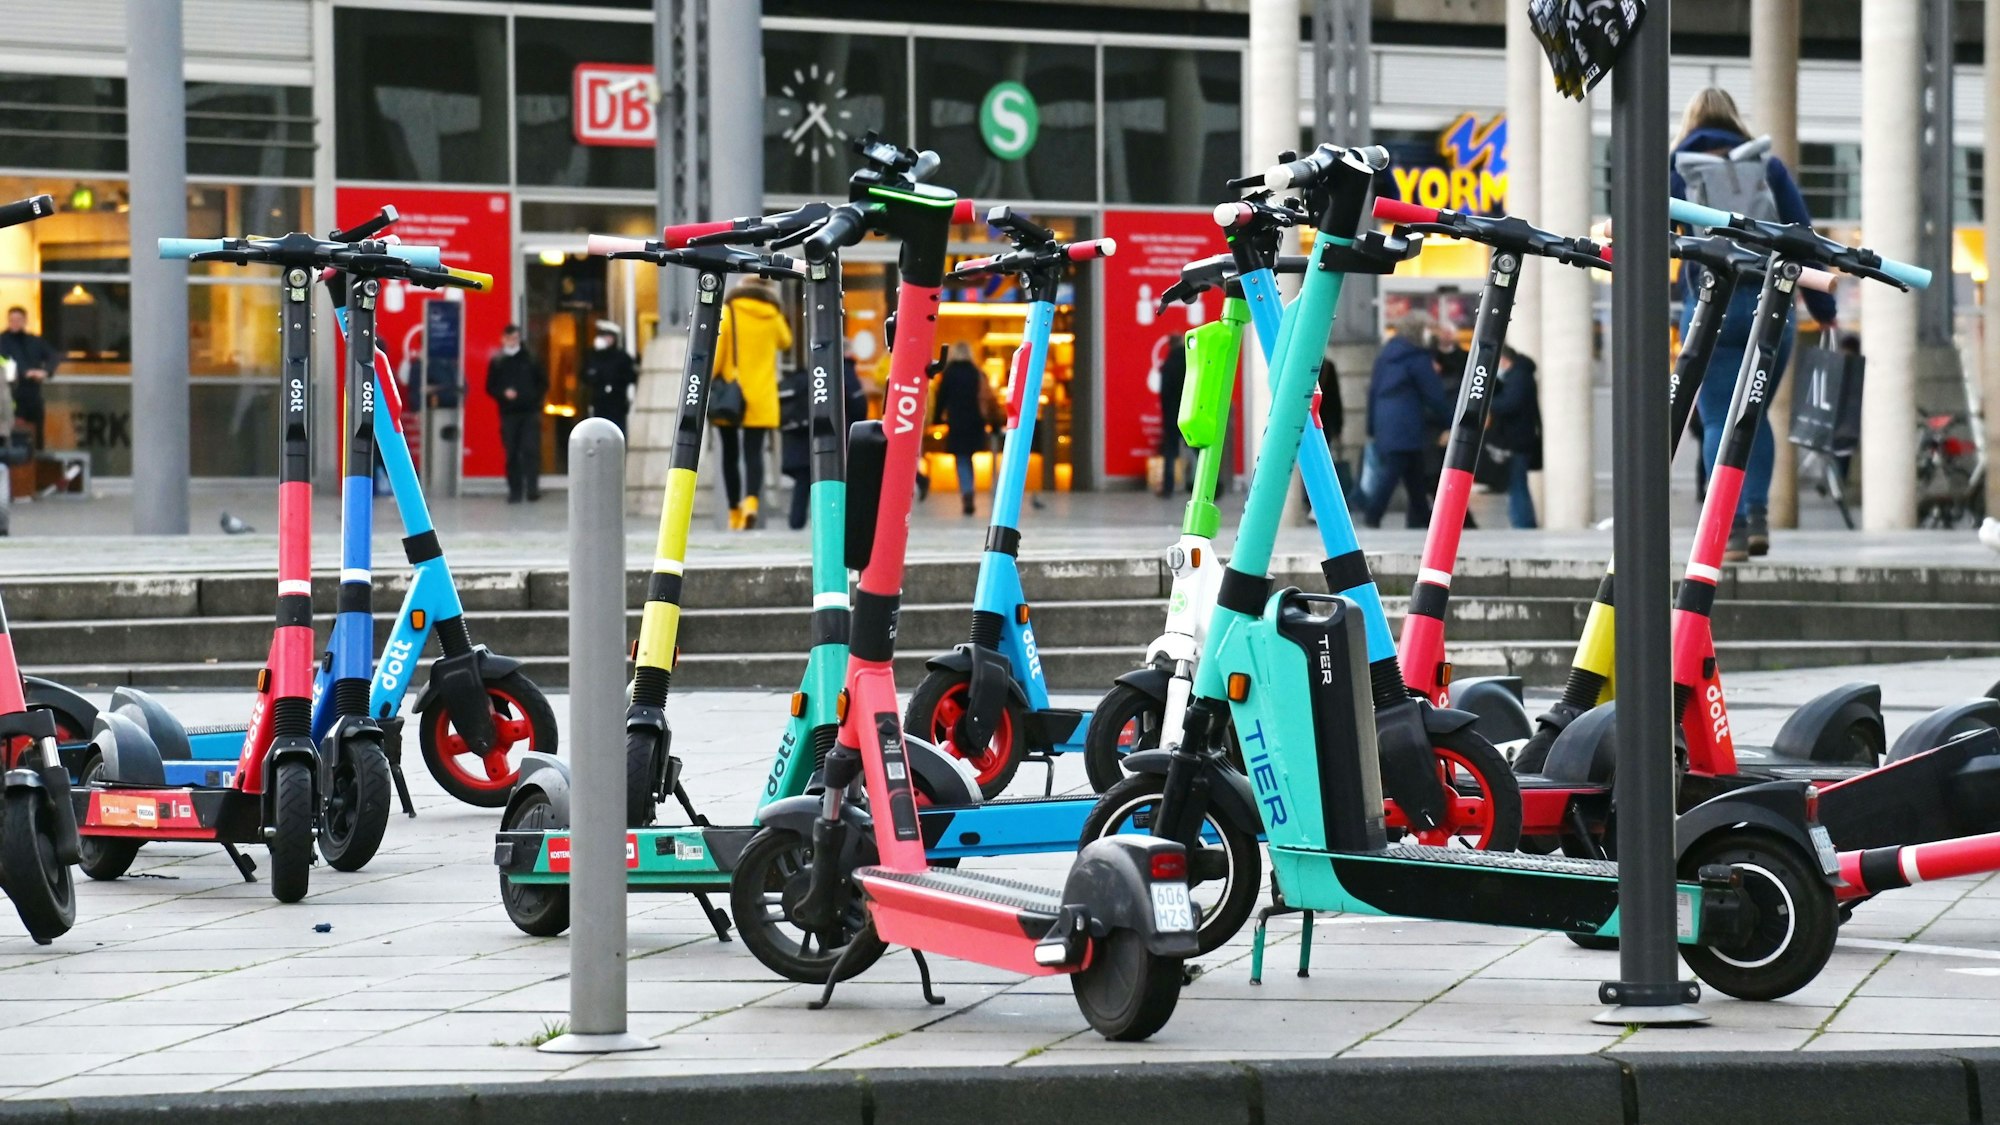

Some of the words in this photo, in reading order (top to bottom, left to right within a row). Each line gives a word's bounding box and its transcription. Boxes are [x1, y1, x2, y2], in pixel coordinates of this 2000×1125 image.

[588, 79, 651, 131] DB
[992, 90, 1029, 152] S
[290, 378, 303, 412] dott
[362, 381, 374, 413] dott
[686, 374, 701, 405] dott
[813, 366, 828, 404] dott
[894, 376, 921, 435] voi.
[1470, 365, 1487, 400] dott
[1749, 369, 1767, 404] dott
[382, 639, 413, 691] dott
[1023, 629, 1042, 680] dott
[1318, 633, 1332, 685] TIER
[243, 702, 265, 759] dott
[1706, 684, 1729, 744] dott
[767, 732, 796, 797] dott
[1245, 718, 1288, 830] TIER
[1157, 887, 1184, 906] 606
[1158, 909, 1189, 928] HZS
